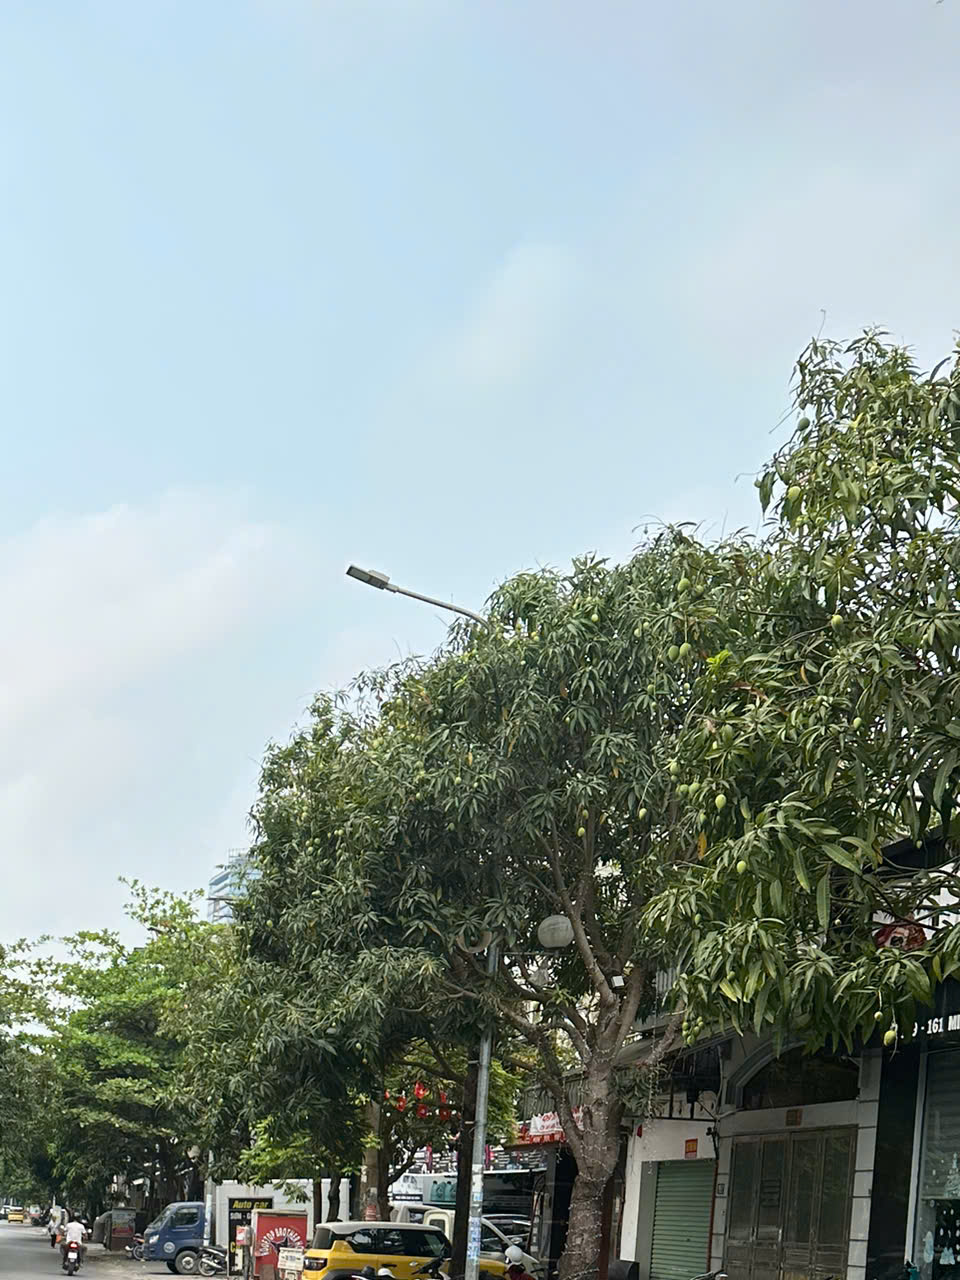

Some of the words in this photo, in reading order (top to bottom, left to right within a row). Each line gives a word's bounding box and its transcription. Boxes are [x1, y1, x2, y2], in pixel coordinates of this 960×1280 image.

[926, 1016, 944, 1034] 161
[232, 1200, 252, 1209] Auto
[253, 1201, 269, 1209] car
